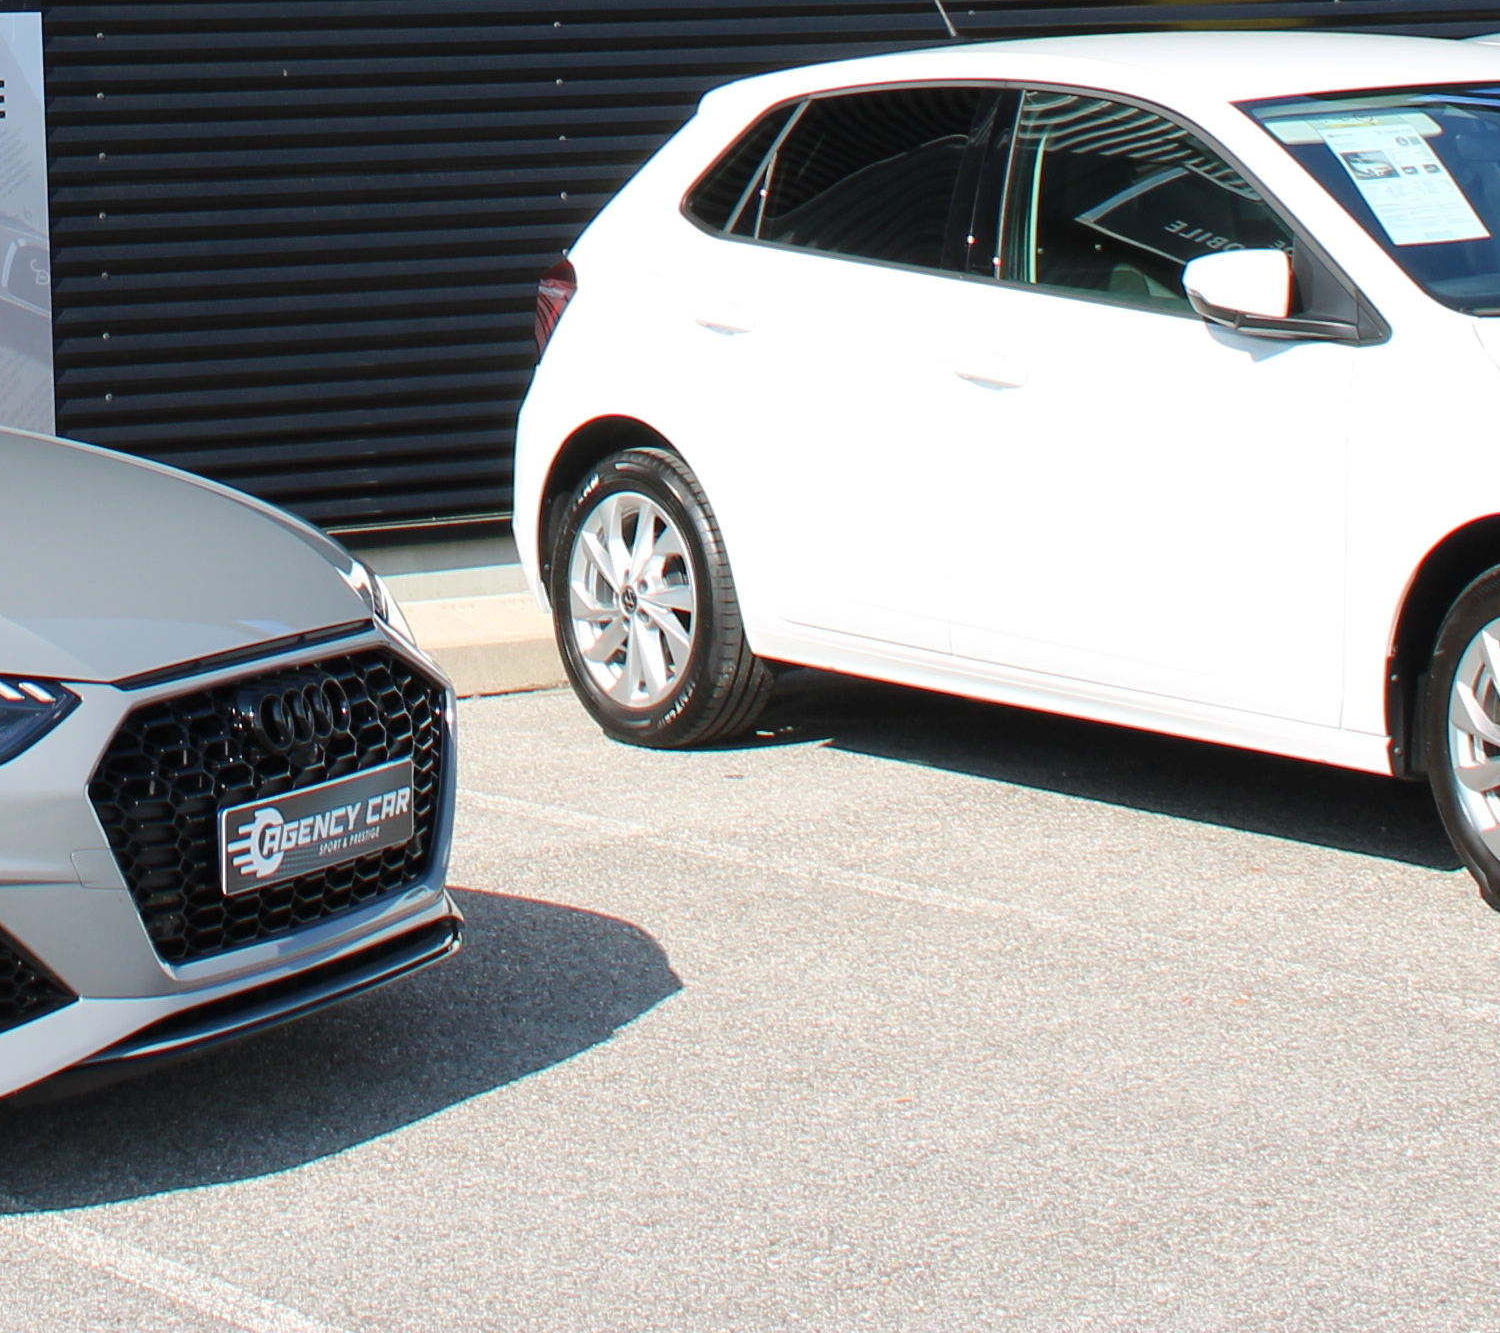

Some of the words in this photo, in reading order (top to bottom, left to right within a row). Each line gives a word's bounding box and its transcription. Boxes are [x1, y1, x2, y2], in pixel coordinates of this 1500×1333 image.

[262, 801, 362, 856] AGENCY
[365, 786, 412, 825] CAR
[318, 840, 342, 857] SPORT
